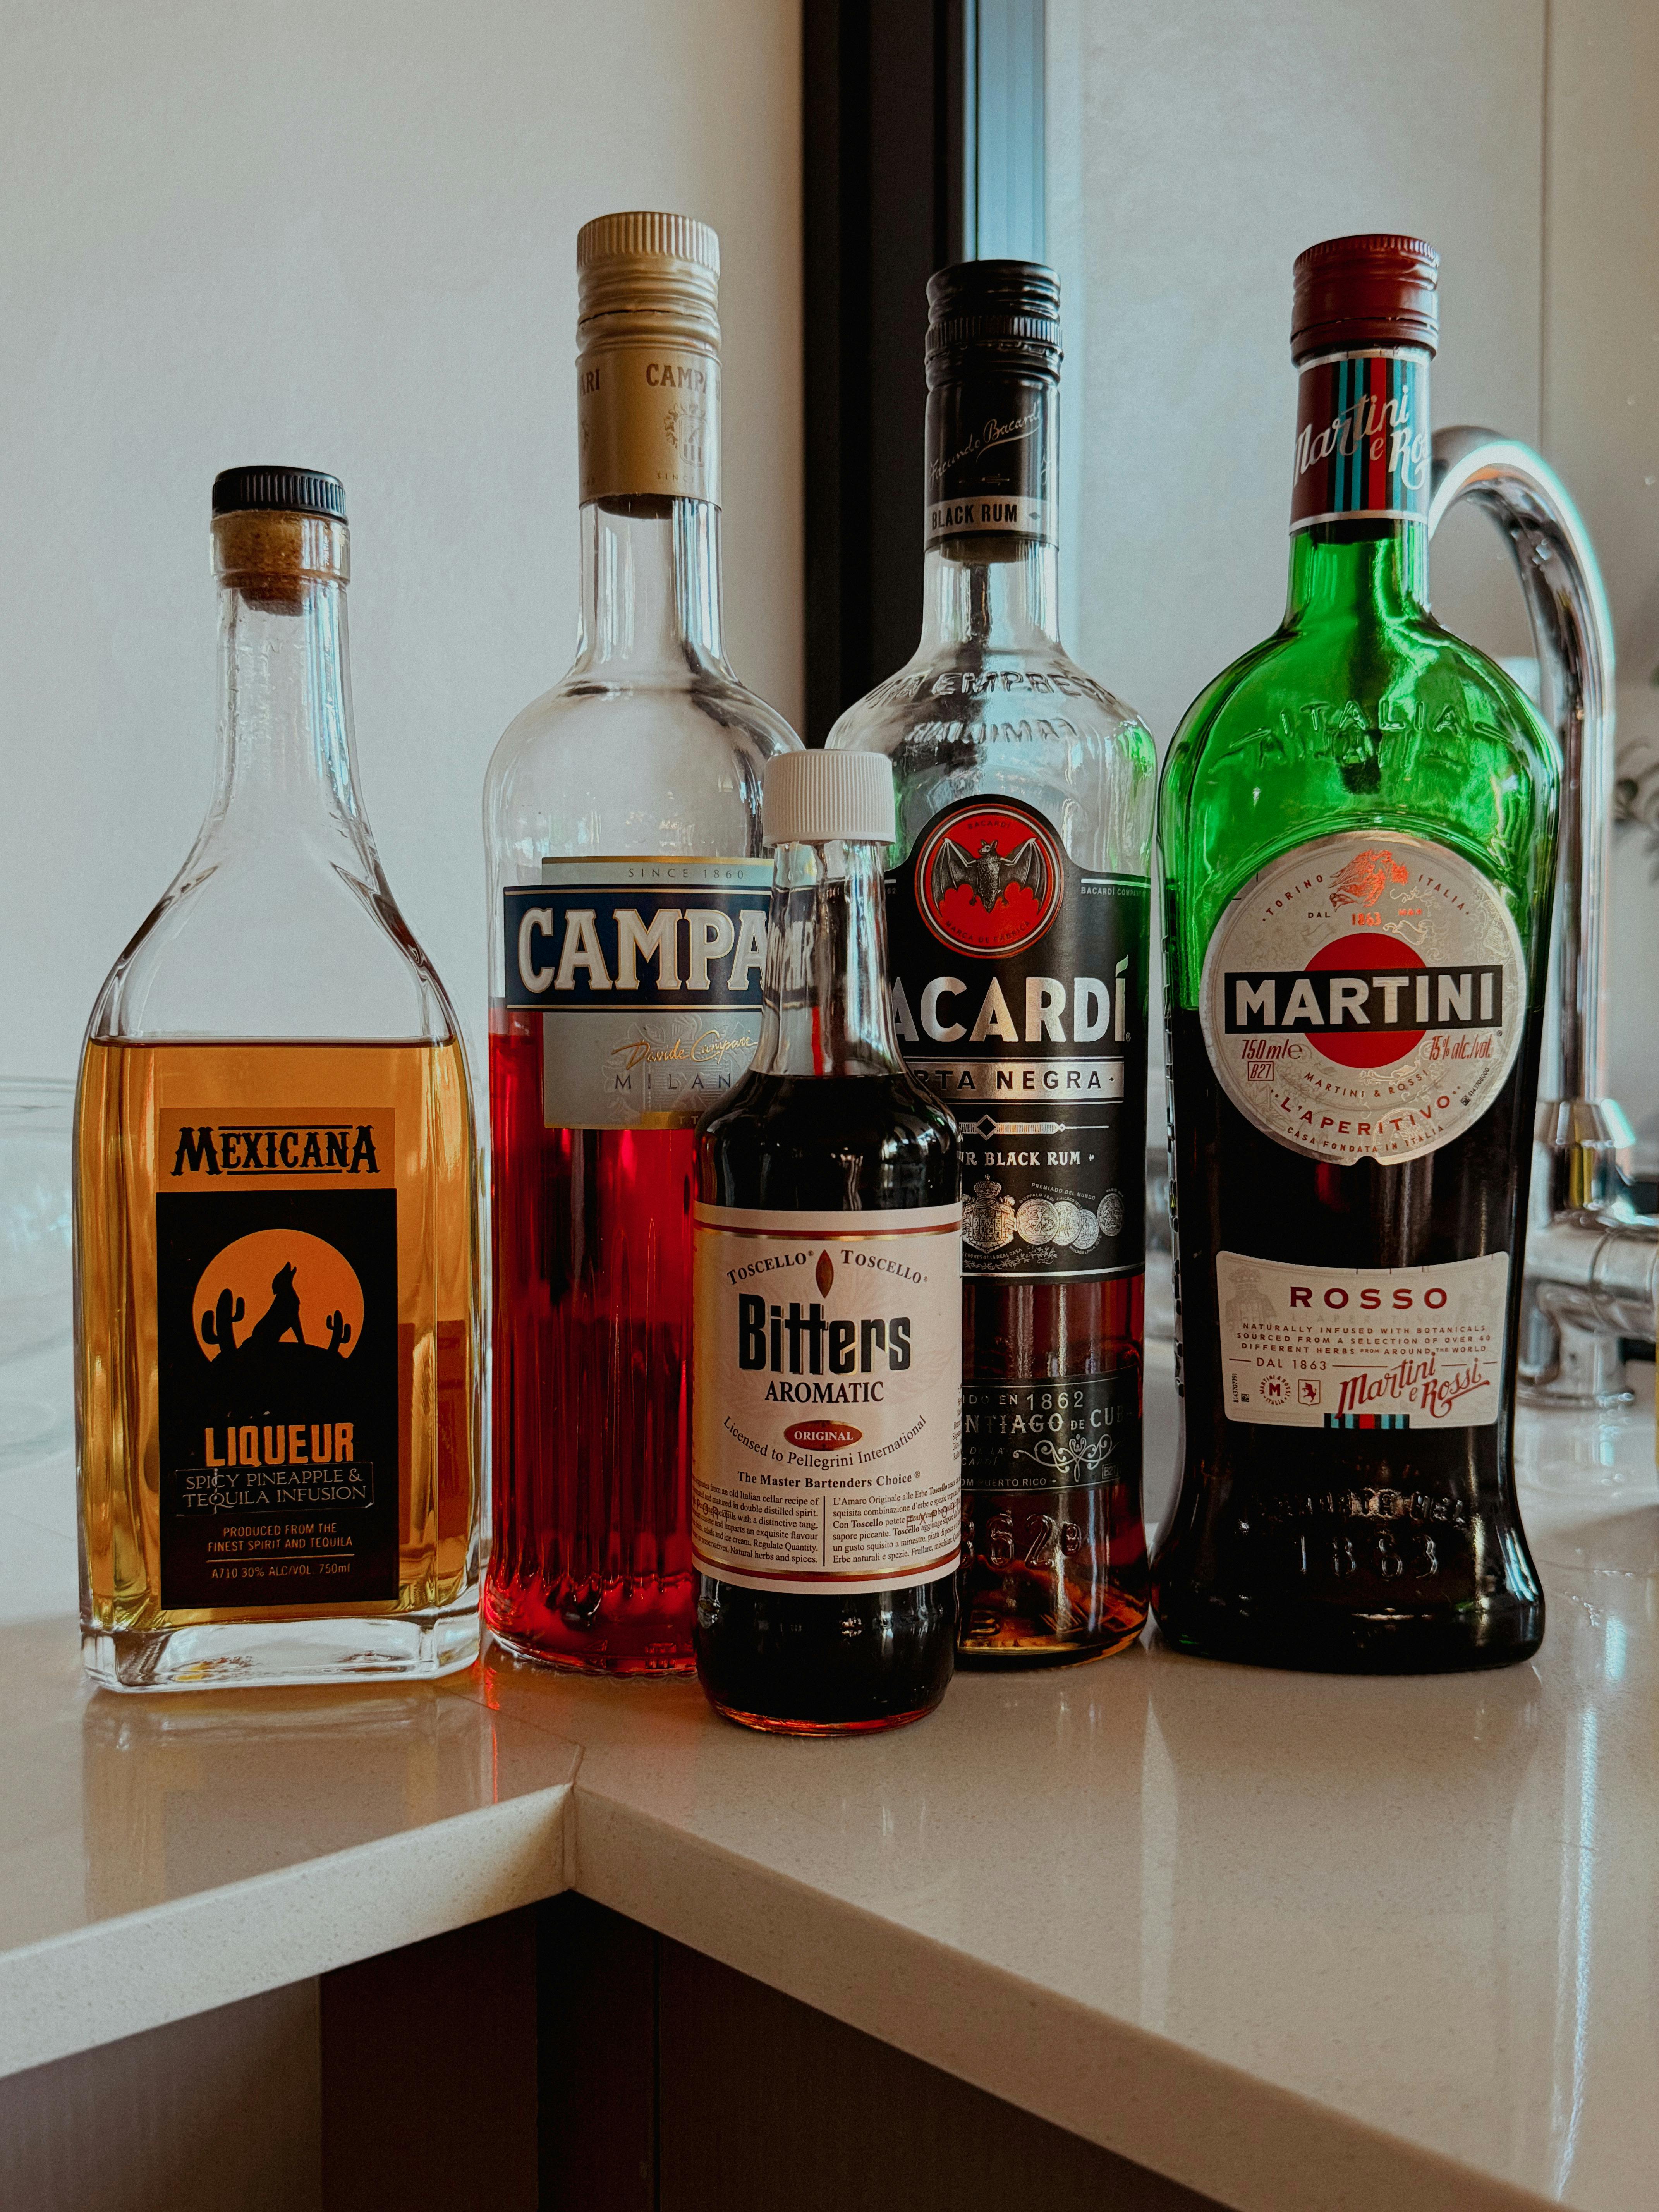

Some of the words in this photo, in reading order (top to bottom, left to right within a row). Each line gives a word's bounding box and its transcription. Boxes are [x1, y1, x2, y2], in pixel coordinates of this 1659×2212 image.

[1294, 385, 1410, 488] Martini
[1370, 438, 1384, 461] e
[932, 505, 974, 530] BLACK
[981, 504, 1017, 522] RUM
[1281, 700, 1464, 735] ITALIA
[629, 868, 690, 878] SINCE
[703, 869, 744, 880] 1860
[1081, 886, 1115, 895] BACARDÍ
[1266, 874, 1323, 916] TORINO
[1418, 874, 1465, 911] ITALIA
[1352, 912, 1381, 926] 1863
[1236, 973, 1493, 1026] MARTINI
[996, 1071, 1101, 1090] NEGRA
[1304, 1072, 1364, 1097] MARTINI
[1389, 1070, 1428, 1094] ROSSI
[1281, 1095, 1450, 1135] L'APERITIVO
[1288, 1127, 1316, 1144] CASA
[1323, 1141, 1377, 1152] FONDATA
[1406, 1126, 1444, 1146] ITALIA
[170, 1125, 381, 1176] MEXICANA
[985, 1152, 1040, 1166] BLACK
[1047, 1151, 1080, 1165] RUM
[1032, 1183, 1063, 1193] PREMIADO
[1077, 1192, 1096, 1200] MUNDO
[1290, 1286, 1447, 1309] ROSSO
[739, 1293, 911, 1375] Bitters
[1237, 1333, 1290, 1342] SOURCED
[1243, 1323, 1312, 1333] NATURALLY
[1417, 1326, 1485, 1334] BOTANICALS
[1242, 1343, 1309, 1353] DIFFERENT
[1257, 1358, 1283, 1368] DAL
[1292, 1360, 1326, 1370] 1863
[764, 1381, 884, 1404] AROMATIC
[1259, 1375, 1275, 1394] MARTINI
[1282, 1379, 1291, 1396] ROSSI
[1269, 1383, 1280, 1396] M
[1334, 1352, 1435, 1419] Martini
[1409, 1388, 1417, 1401] e
[1420, 1357, 1490, 1418] Rossi
[999, 1395, 1018, 1405] EN
[1027, 1391, 1084, 1411] 1862
[1071, 1418, 1085, 1430] DE
[205, 1423, 353, 1467] LIQUEUR
[723, 1415, 767, 1456] Licensed
[771, 1448, 783, 1462] to
[787, 1451, 854, 1471] Pellegrini
[858, 1415, 926, 1464] International
[794, 1431, 854, 1441] ORIGINAL
[186, 1473, 240, 1490] SPICY
[247, 1469, 343, 1487] PINEAPPLE
[349, 1468, 363, 1482] &
[738, 1471, 757, 1484] The
[760, 1474, 801, 1487] Master
[805, 1477, 872, 1488] Bartenders
[876, 1473, 912, 1486] Choice
[182, 1490, 270, 1508] TEQUILA
[276, 1486, 366, 1503] INFUSION
[740, 1491, 760, 1501] Italian
[763, 1494, 782, 1503] cellar
[785, 1497, 808, 1506] recipe
[869, 1494, 901, 1504] Originale
[929, 1484, 948, 1495] Toscello
[713, 1497, 732, 1507] matured
[740, 1503, 762, 1513] double
[764, 1506, 793, 1516] distilled
[796, 1509, 818, 1518] spirit.
[833, 1509, 862, 1518] squisita
[864, 1505, 910, 1515] combinazione
[223, 1525, 281, 1537] PRODUCED
[285, 1524, 314, 1534] FROM
[318, 1523, 337, 1533] THE
[725, 1523, 745, 1533] imparts
[756, 1529, 788, 1539] exquisite
[791, 1531, 818, 1540] flavour
[759, 1516, 797, 1528] distinctive
[799, 1520, 818, 1530] tang,
[851, 1519, 883, 1528] Toscello
[885, 1517, 905, 1527] potete
[833, 1533, 857, 1542] sapore
[859, 1531, 891, 1541] piccante.
[893, 1525, 920, 1536] Toscello
[208, 1541, 244, 1552] FINEST
[248, 1539, 280, 1551] SPIRIT
[285, 1538, 306, 1549] AND
[311, 1536, 353, 1547] TEQUILA
[733, 1536, 752, 1546] cream.
[754, 1540, 783, 1549] Regulate
[785, 1542, 818, 1553] Quantity.
[845, 1544, 864, 1553] gusto
[867, 1541, 893, 1553] squisito
[901, 1535, 927, 1546] minestre,
[730, 1546, 752, 1558] Natural
[755, 1551, 774, 1560] herbs
[792, 1556, 818, 1564] spices.
[833, 1555, 850, 1563] Erbe
[853, 1553, 880, 1563] naturali
[888, 1551, 909, 1561] spezie.
[912, 1546, 934, 1556] Frullare,
[212, 1568, 237, 1579] A710
[242, 1566, 264, 1578] 30%
[319, 1563, 350, 1574] 750ml
